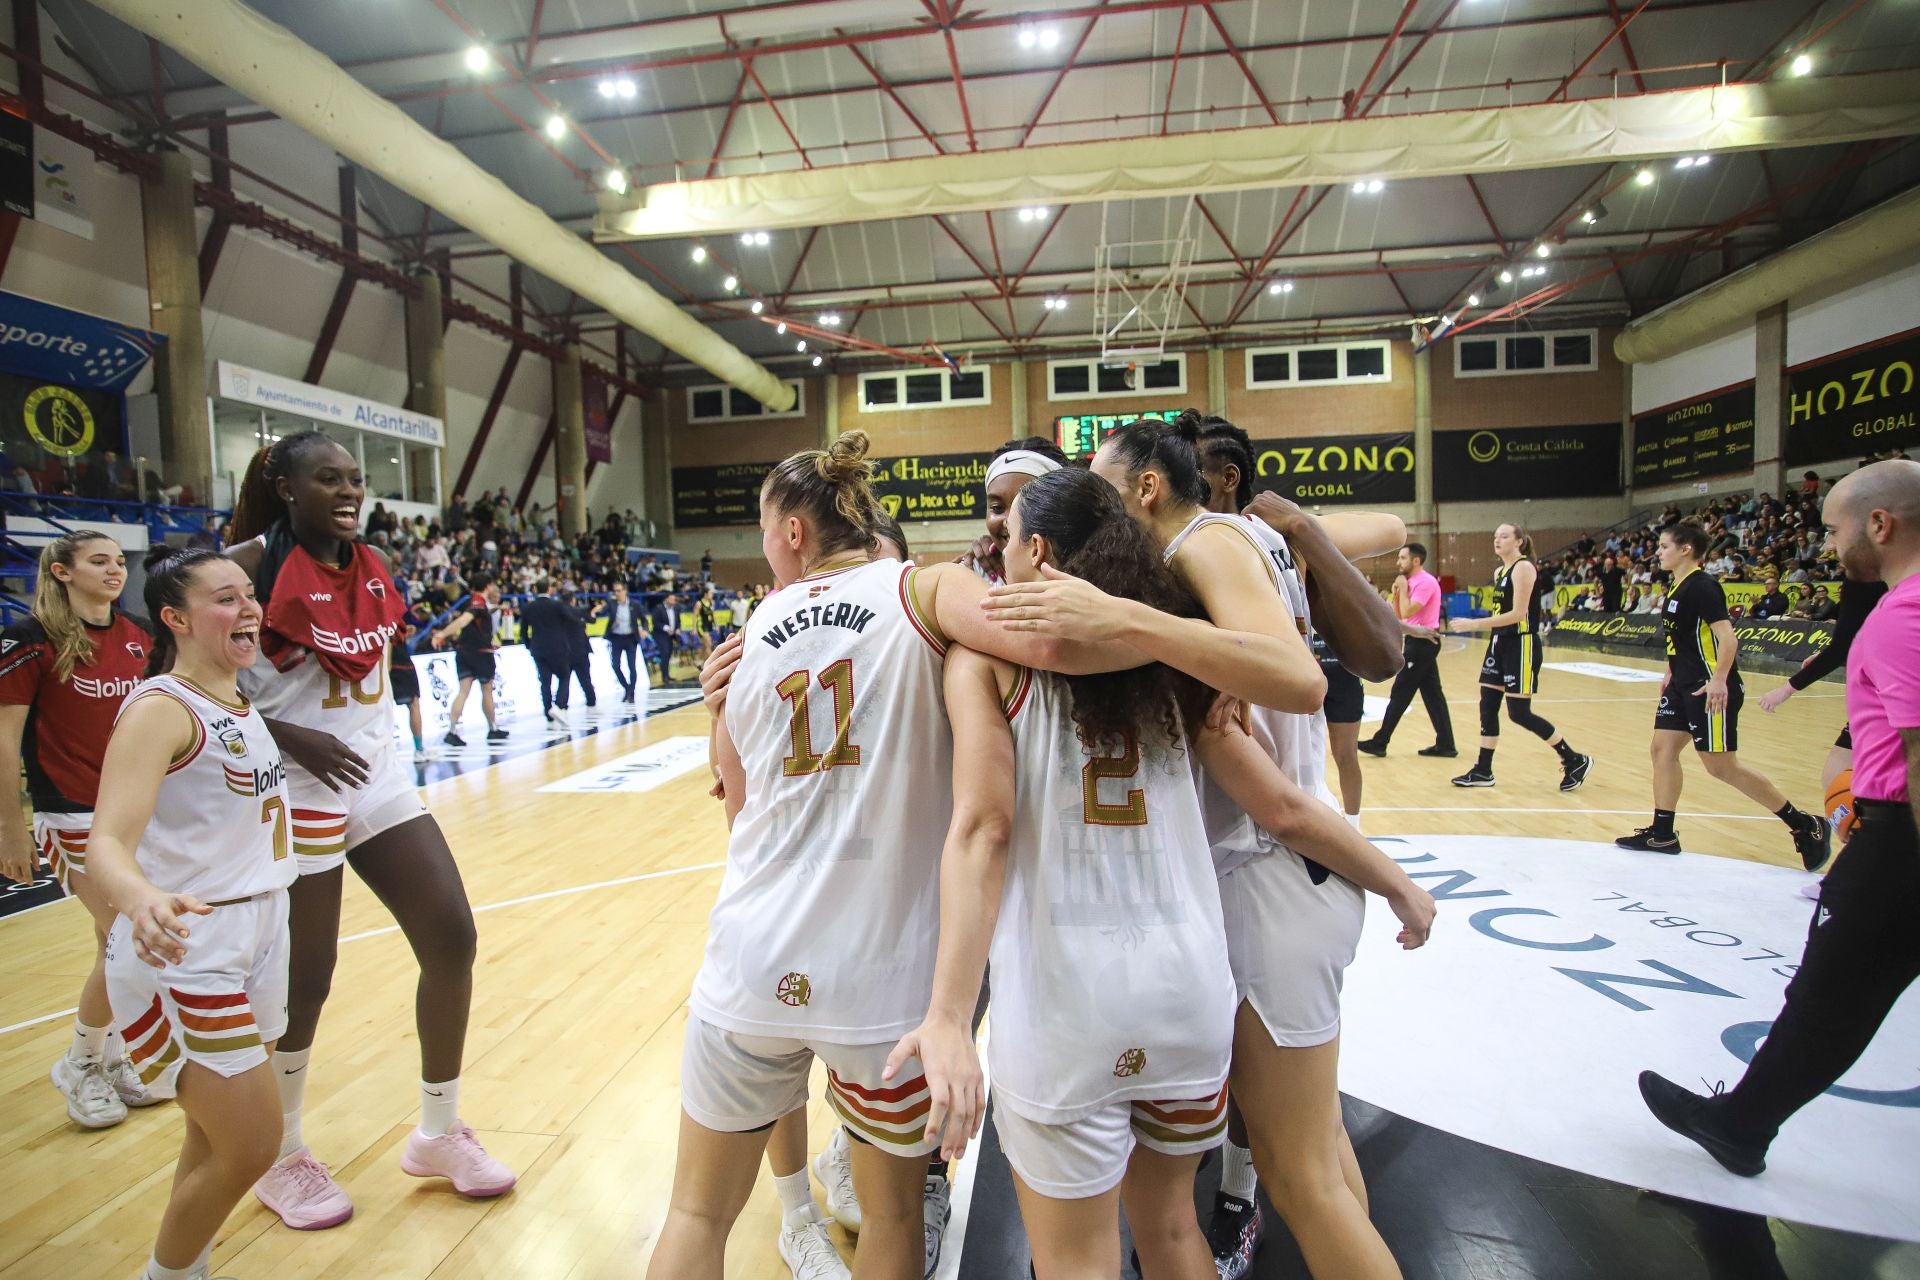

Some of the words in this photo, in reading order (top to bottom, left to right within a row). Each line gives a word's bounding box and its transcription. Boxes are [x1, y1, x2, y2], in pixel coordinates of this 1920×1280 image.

[256, 385, 329, 414] Ayuntamiento
[330, 402, 342, 416] de
[354, 404, 439, 442] Alcantarilla
[1667, 403, 1713, 424] HOZONO
[1852, 412, 1917, 437] GLOBAL
[1506, 440, 1541, 453] Costa
[900, 457, 987, 480] Hacienda
[1256, 445, 1415, 477] OZONO
[945, 493, 959, 508] te
[1295, 483, 1353, 497] GLOBAL
[309, 592, 332, 602] vive
[761, 602, 877, 650] WESTERIK
[96, 675, 143, 698] loint
[211, 716, 236, 731] vive
[776, 658, 861, 777] 11
[253, 755, 286, 797] loint
[1081, 730, 1148, 825] 2
[261, 795, 288, 862] 7
